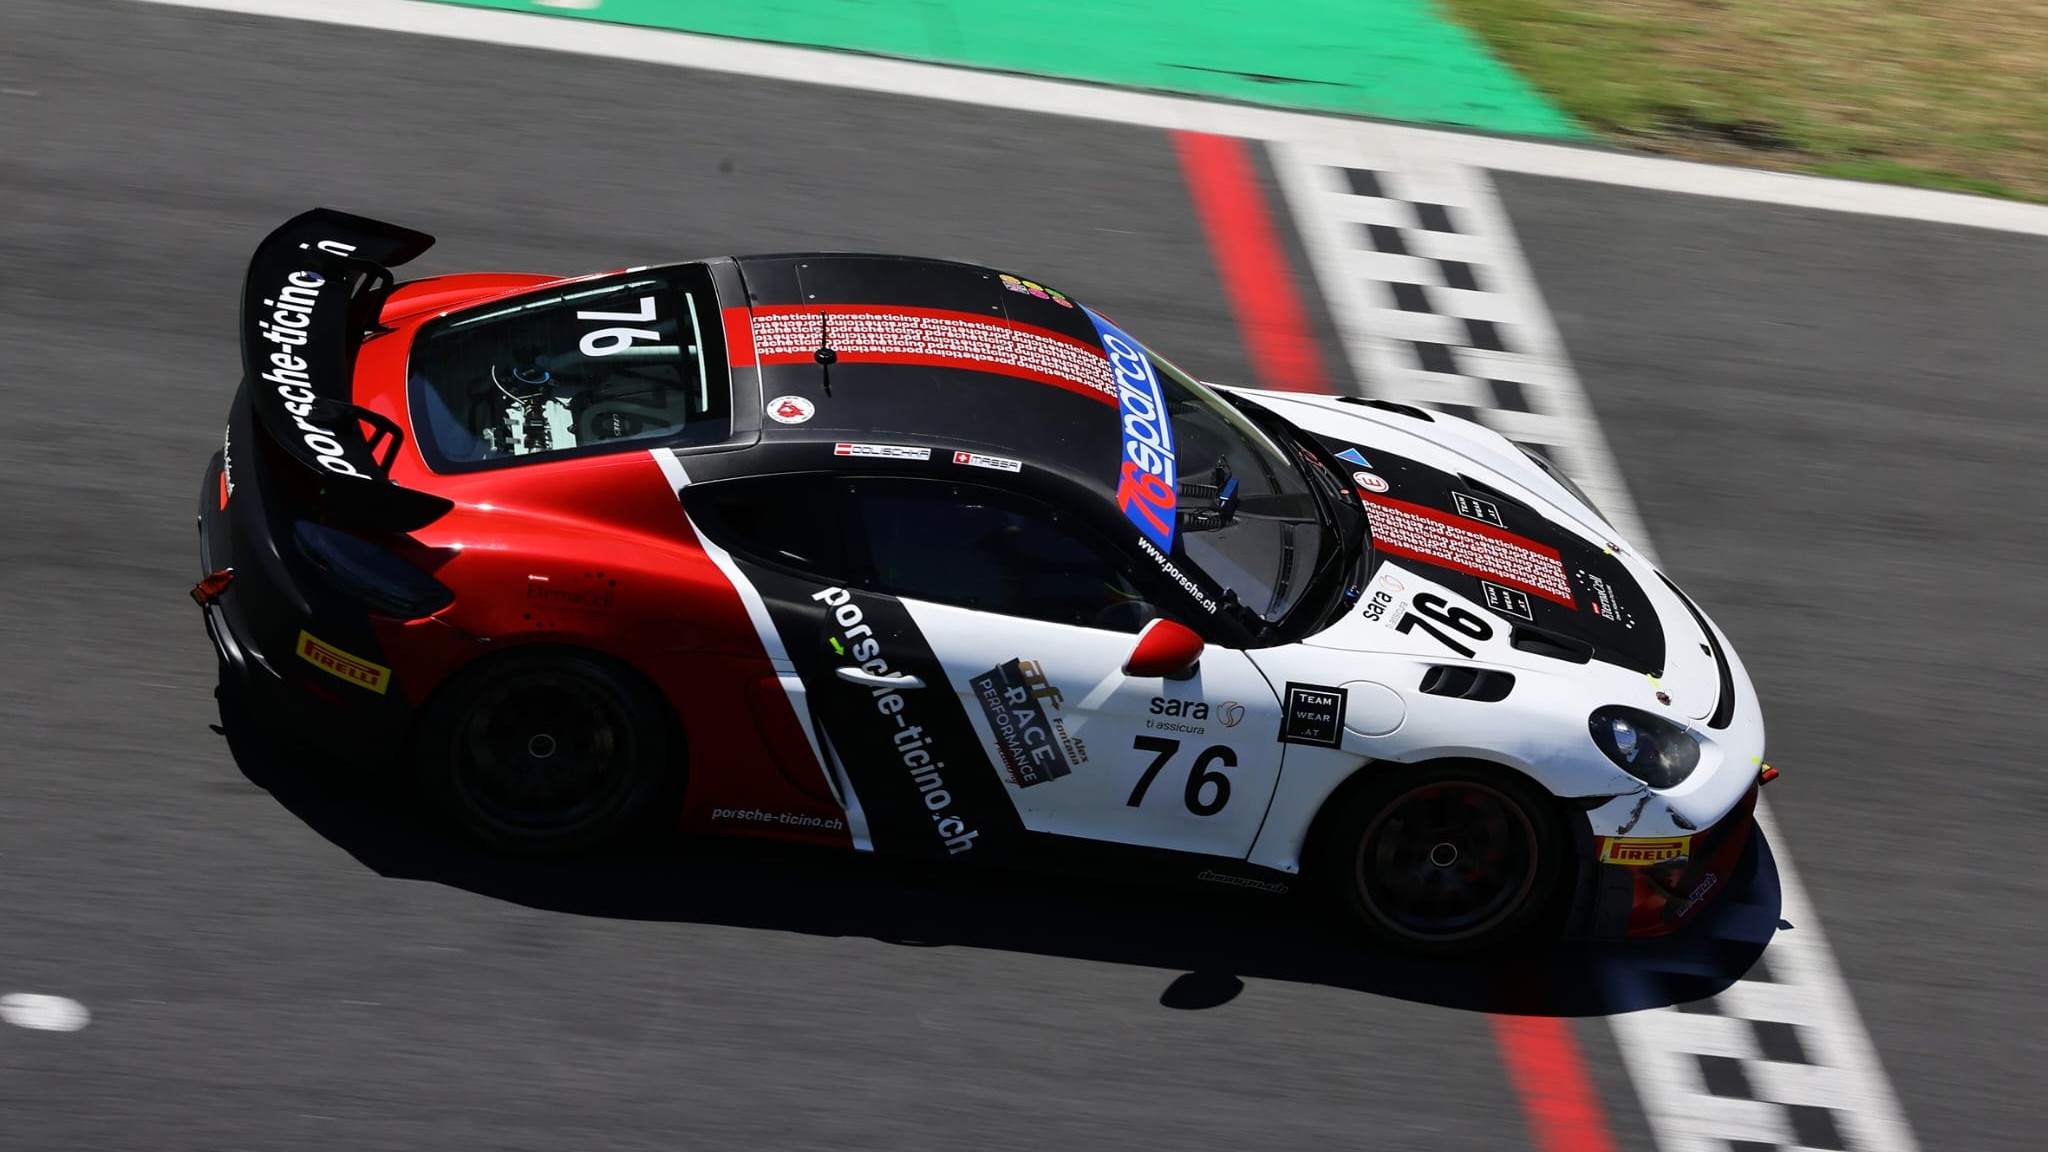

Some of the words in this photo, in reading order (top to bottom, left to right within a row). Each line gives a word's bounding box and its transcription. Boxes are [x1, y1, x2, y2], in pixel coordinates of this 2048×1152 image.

[576, 296, 661, 357] 76
[829, 312, 918, 323] porscheticino
[922, 315, 1010, 335] porscheticino
[1103, 333, 1174, 475] sparco
[970, 456, 1018, 470] MASSA
[1117, 461, 1176, 537] 76
[1137, 536, 1217, 615] www.porsche.ch
[1362, 591, 1393, 622] sara
[1395, 592, 1494, 659] 76
[304, 639, 381, 686] PIRELLI
[1149, 697, 1209, 721] sara
[1296, 710, 1331, 723] WEAR
[1299, 692, 1332, 707] TEAM
[979, 678, 1037, 781] PERFORMANCE
[1004, 685, 1056, 765] RACE
[1155, 721, 1205, 735] assicura
[1126, 735, 1238, 817] 76
[712, 808, 843, 830] porsche-ticino.ch
